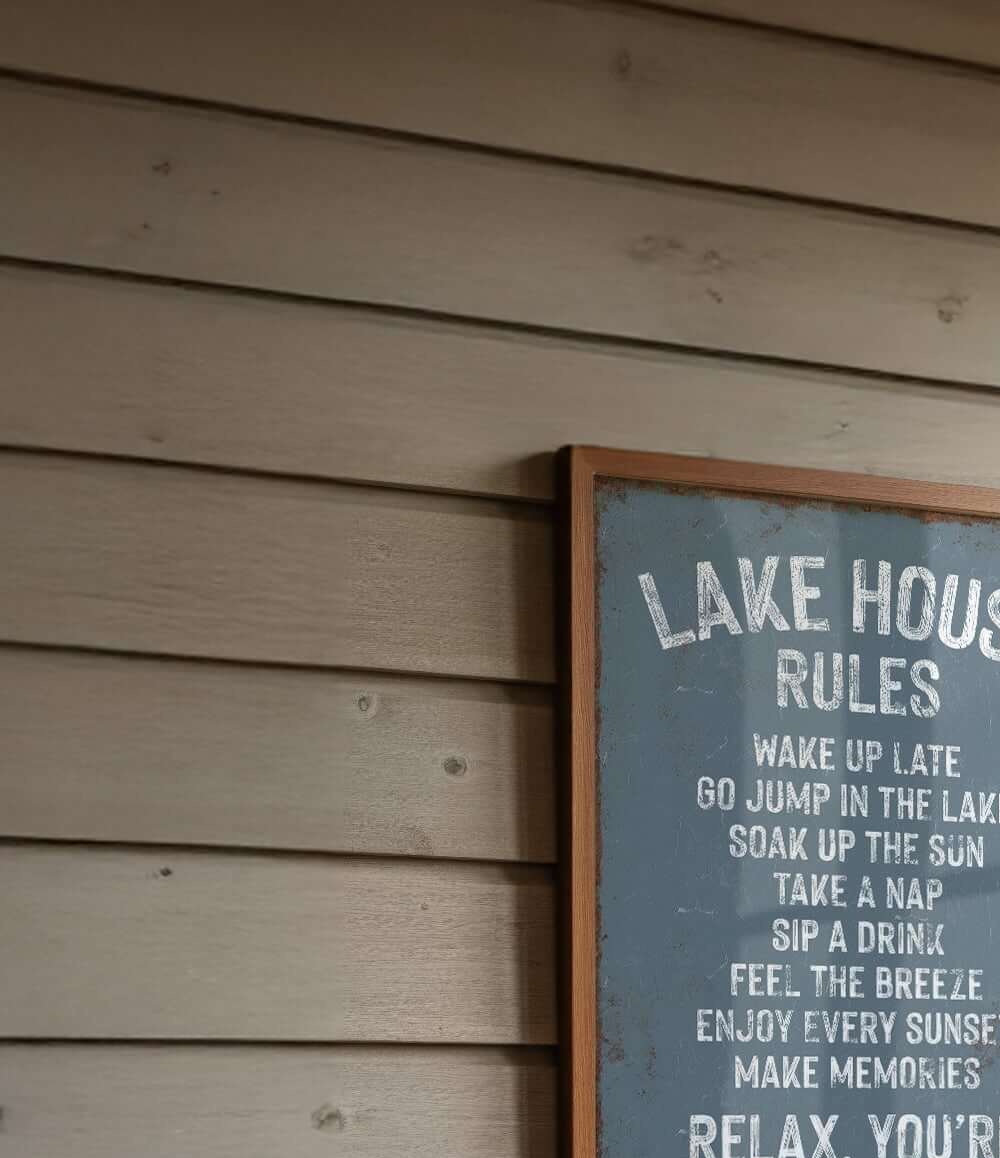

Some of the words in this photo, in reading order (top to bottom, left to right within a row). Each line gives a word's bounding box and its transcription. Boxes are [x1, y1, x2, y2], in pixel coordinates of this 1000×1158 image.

[638, 556, 830, 650] LAKE
[777, 648, 940, 719] RULES
[753, 733, 835, 770] WAKE
[846, 739, 882, 773] UP
[893, 742, 961, 778] LATE
[697, 776, 735, 809] GO
[746, 780, 830, 816] JUMP
[840, 784, 869, 818] IN
[879, 786, 930, 820] THE
[729, 825, 808, 861] SOAK
[818, 829, 855, 862] UP
[865, 831, 919, 865] THE
[929, 833, 984, 868] SUN
[773, 872, 847, 908] TAKE
[858, 876, 876, 908] A
[886, 877, 943, 910] NAP
[772, 919, 819, 952] SIP
[829, 922, 847, 953] A
[858, 922, 945, 955] DRINK
[730, 963, 800, 998] FEEL
[810, 965, 864, 999] THE
[875, 968, 984, 1000] BREEZE
[696, 1010, 793, 1043] ENJOY
[804, 1010, 897, 1044] EVERY
[734, 1055, 819, 1088] MAKE
[831, 1056, 981, 1089] MEMORIES
